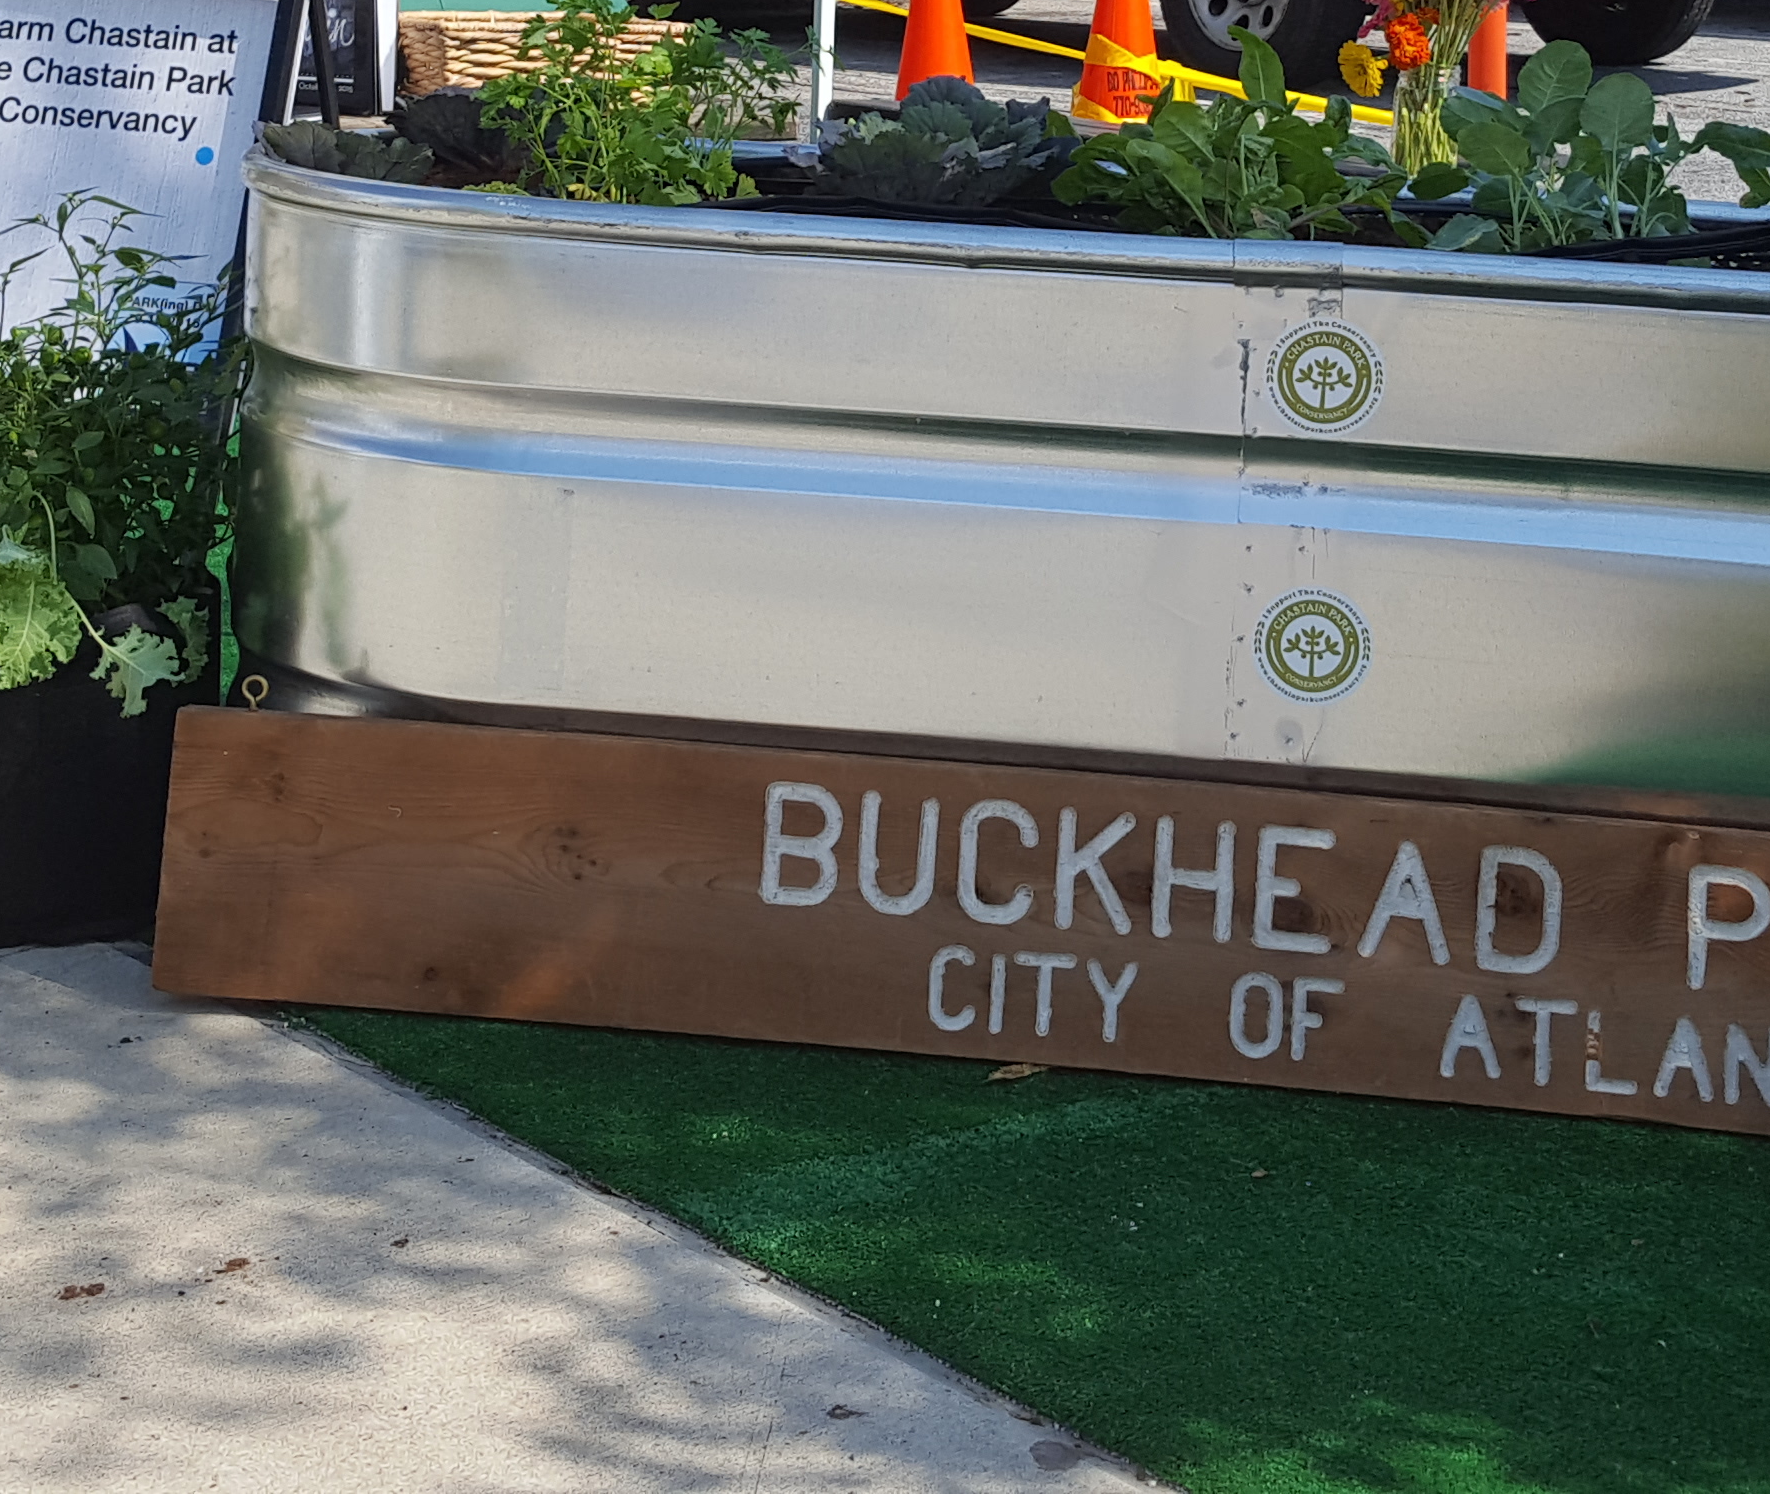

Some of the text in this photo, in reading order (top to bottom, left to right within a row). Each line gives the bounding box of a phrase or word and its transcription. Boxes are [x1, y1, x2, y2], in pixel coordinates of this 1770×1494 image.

[65, 17, 197, 52] Chastain
[207, 29, 238, 54] at
[23, 56, 155, 90] Chastain
[165, 66, 236, 96] Park
[1280, 322, 1311, 344] Support
[1331, 321, 1377, 358] Conservancy
[1286, 334, 1367, 368] CHASTAIN PARK
[1296, 403, 1348, 419] CONSERVANCY
[1266, 592, 1296, 614] Support
[1316, 590, 1363, 625] Conservancy
[1273, 603, 1354, 635] CHASTAIN PARK
[1285, 672, 1337, 688] CONSERVANCY
[757, 780, 1564, 975] BUCKHEAD
[928, 943, 1139, 1043] CITY
[1229, 970, 1346, 1062] OF
